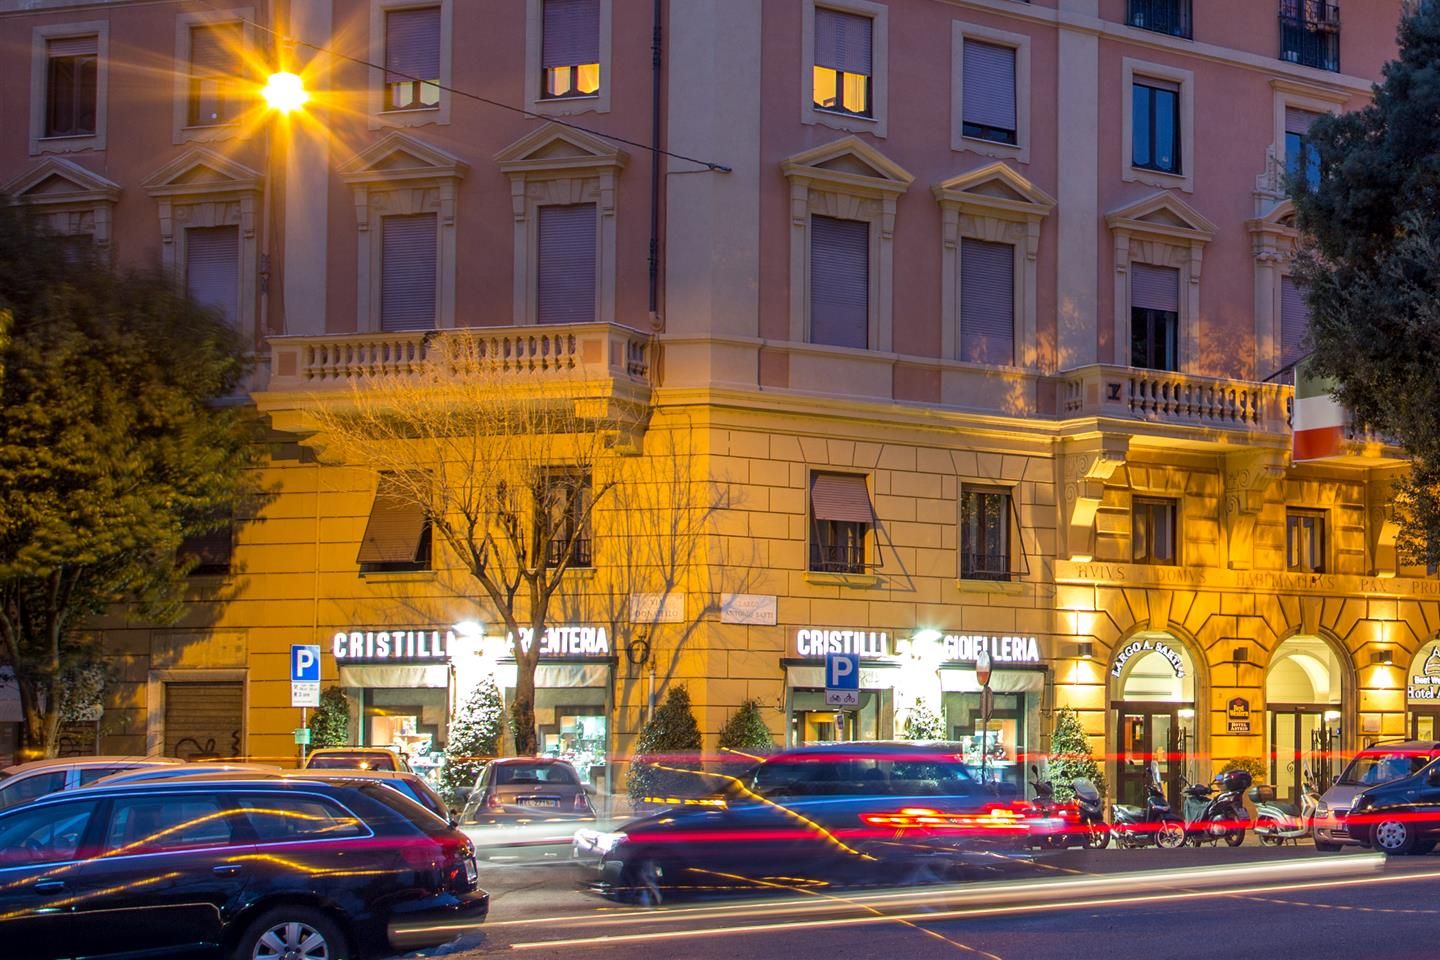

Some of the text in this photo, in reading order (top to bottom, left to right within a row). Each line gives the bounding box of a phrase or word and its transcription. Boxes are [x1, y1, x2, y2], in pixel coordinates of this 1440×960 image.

[1078, 565, 1125, 580] HVIVS
[1159, 568, 1206, 583] DOMVS
[1361, 578, 1388, 592] PAX
[797, 629, 888, 657] CRISTILLI
[297, 650, 314, 677] P
[832, 656, 854, 686] P
[1111, 642, 1141, 679] LARGO
[1408, 685, 1434, 699] Hotel
[1414, 676, 1430, 685] Best
